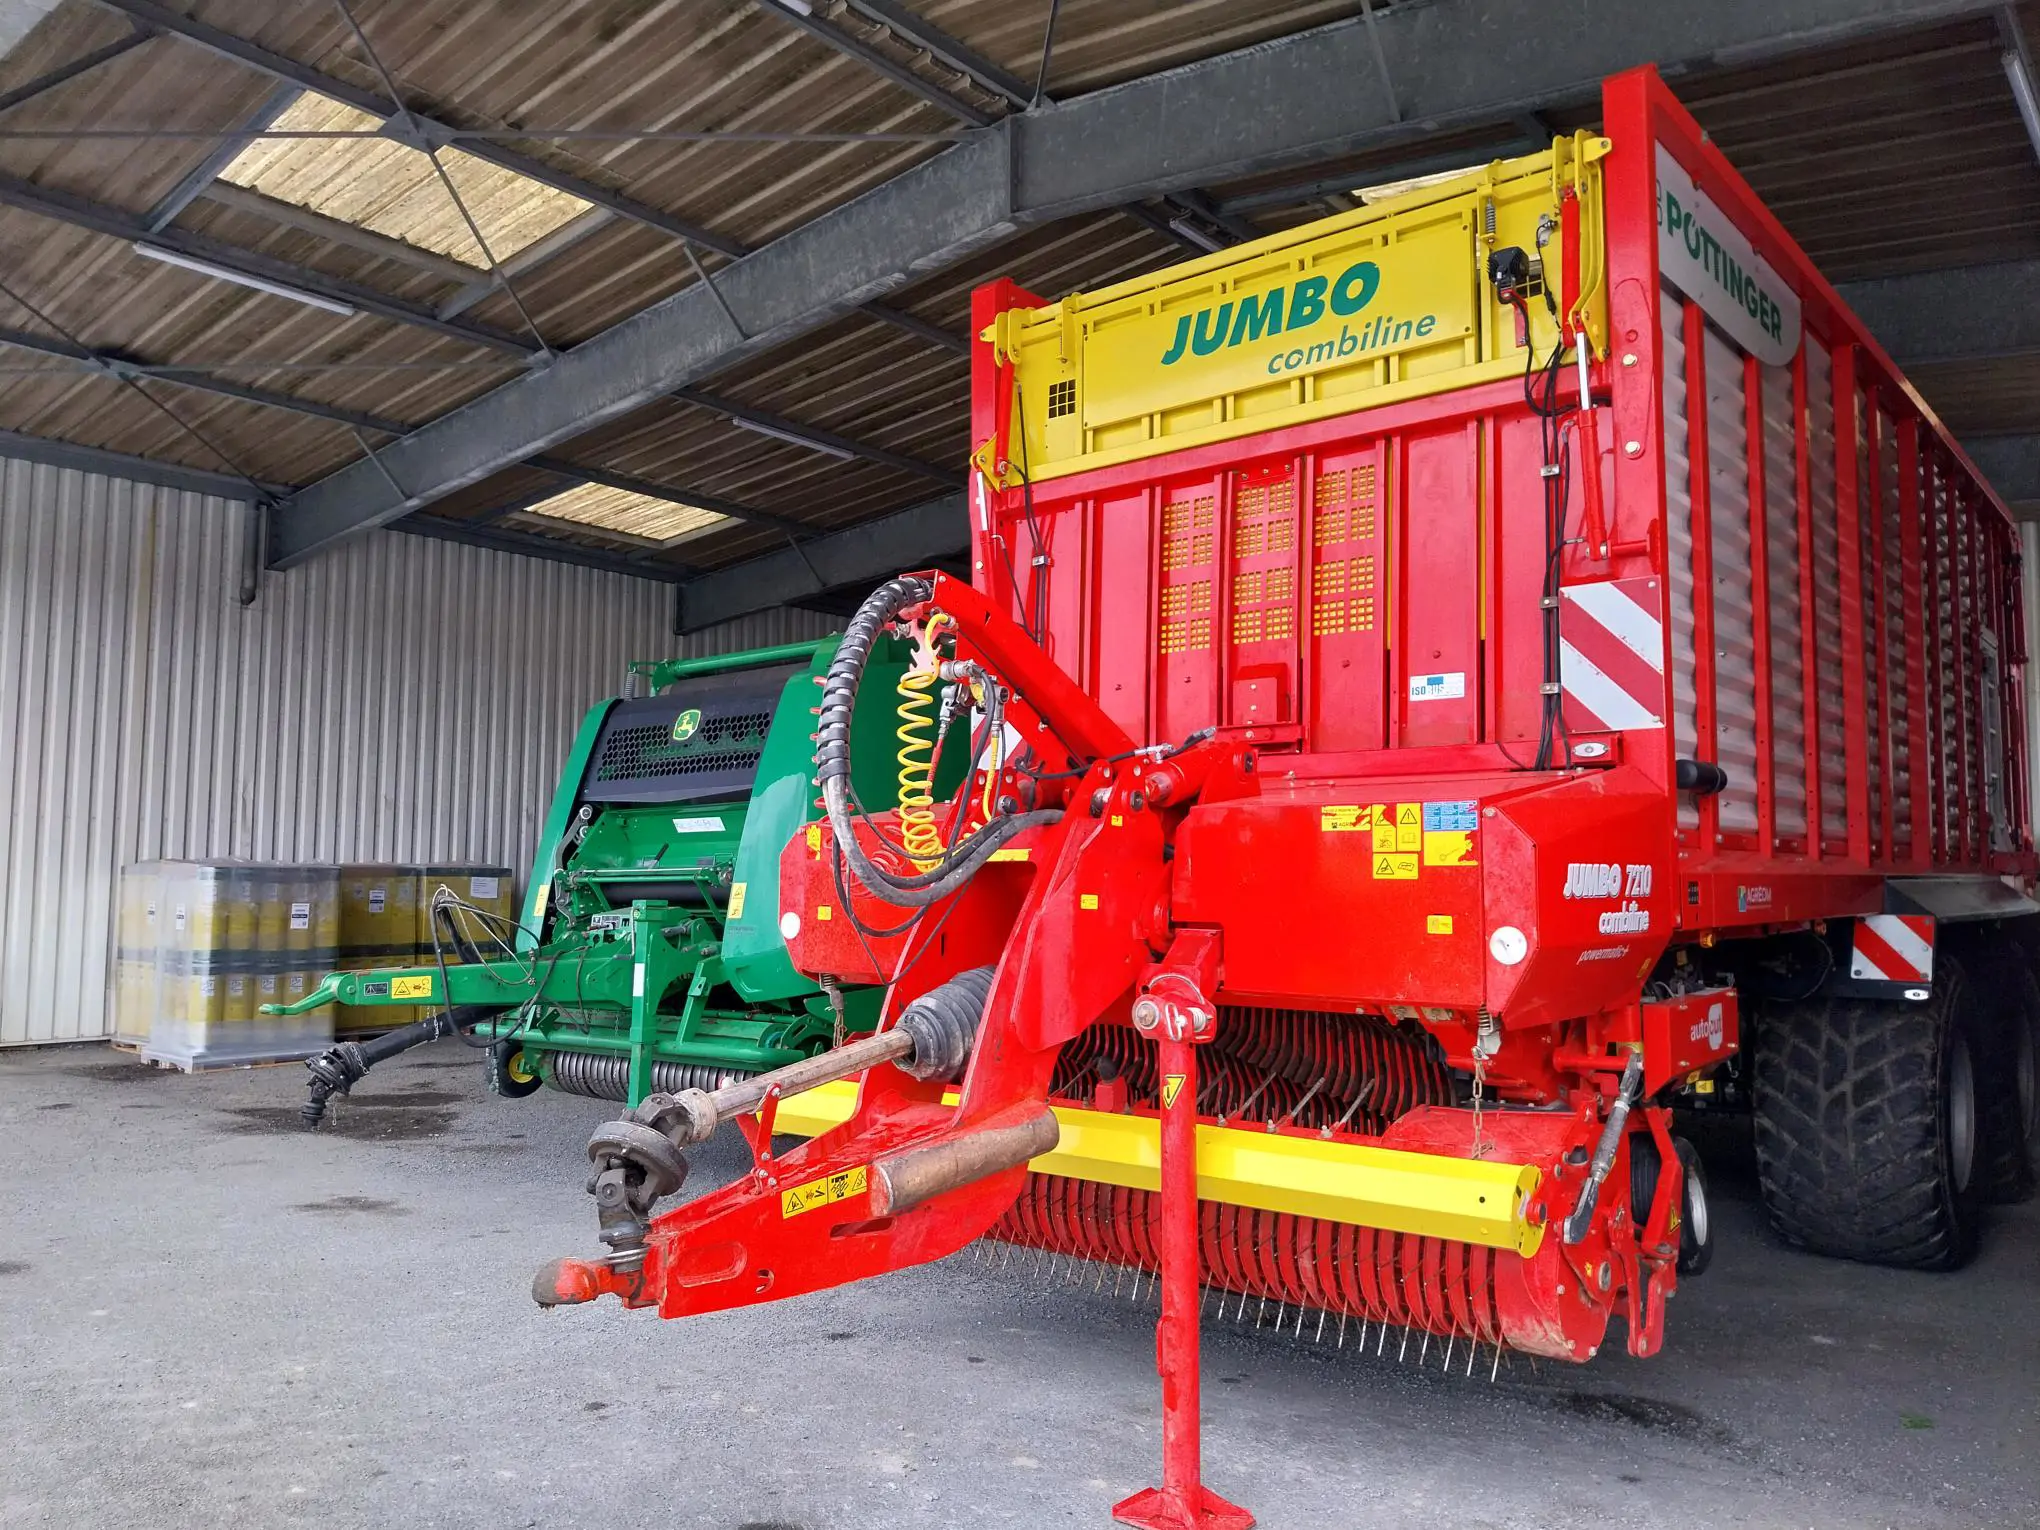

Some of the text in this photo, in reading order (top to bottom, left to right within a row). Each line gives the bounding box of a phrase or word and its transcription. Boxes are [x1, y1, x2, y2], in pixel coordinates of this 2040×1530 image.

[1161, 261, 1380, 366] JUMBO
[1267, 314, 1436, 375] combiline
[1563, 863, 1622, 899] JUMBO
[1624, 864, 1652, 898] 7210
[1599, 900, 1650, 935] combiline
